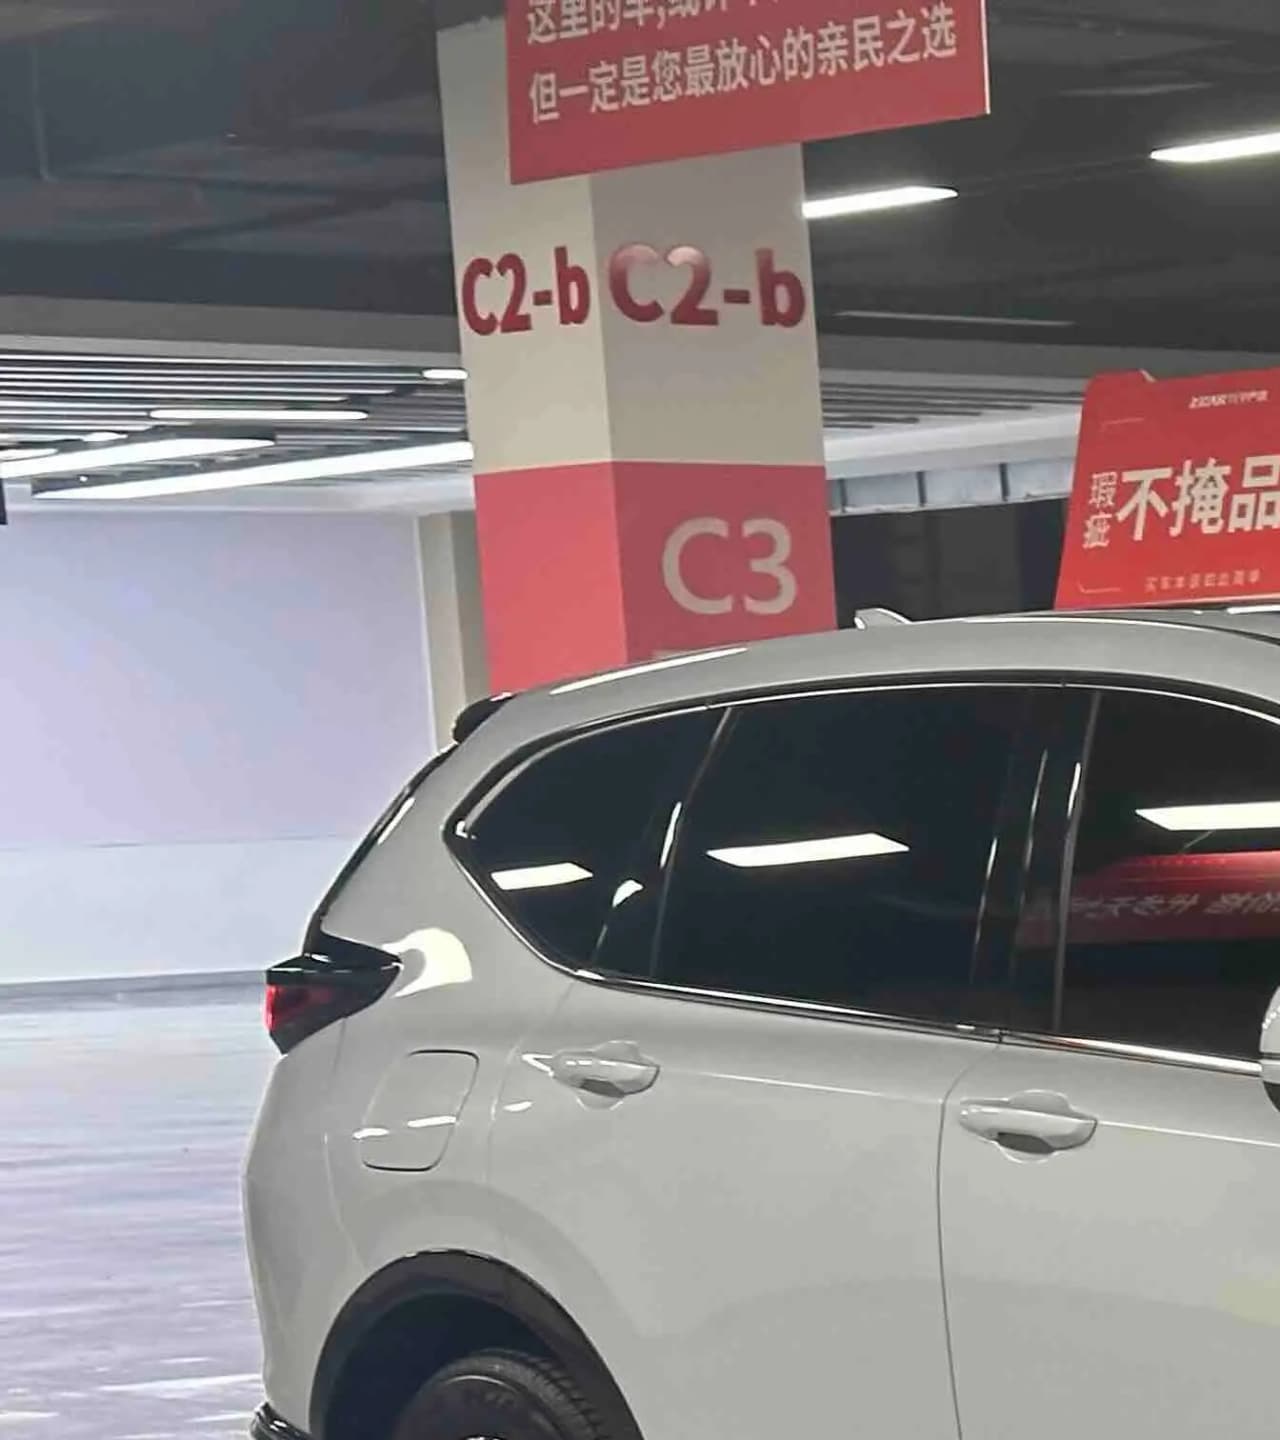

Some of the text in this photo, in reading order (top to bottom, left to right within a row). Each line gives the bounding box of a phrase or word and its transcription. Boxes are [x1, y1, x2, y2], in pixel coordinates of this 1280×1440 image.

[528, 2, 957, 125] 但一定是您最放心的亲民之选
[461, 246, 590, 336] C2-b
[608, 243, 806, 328] C2-b
[662, 517, 797, 615] C3
